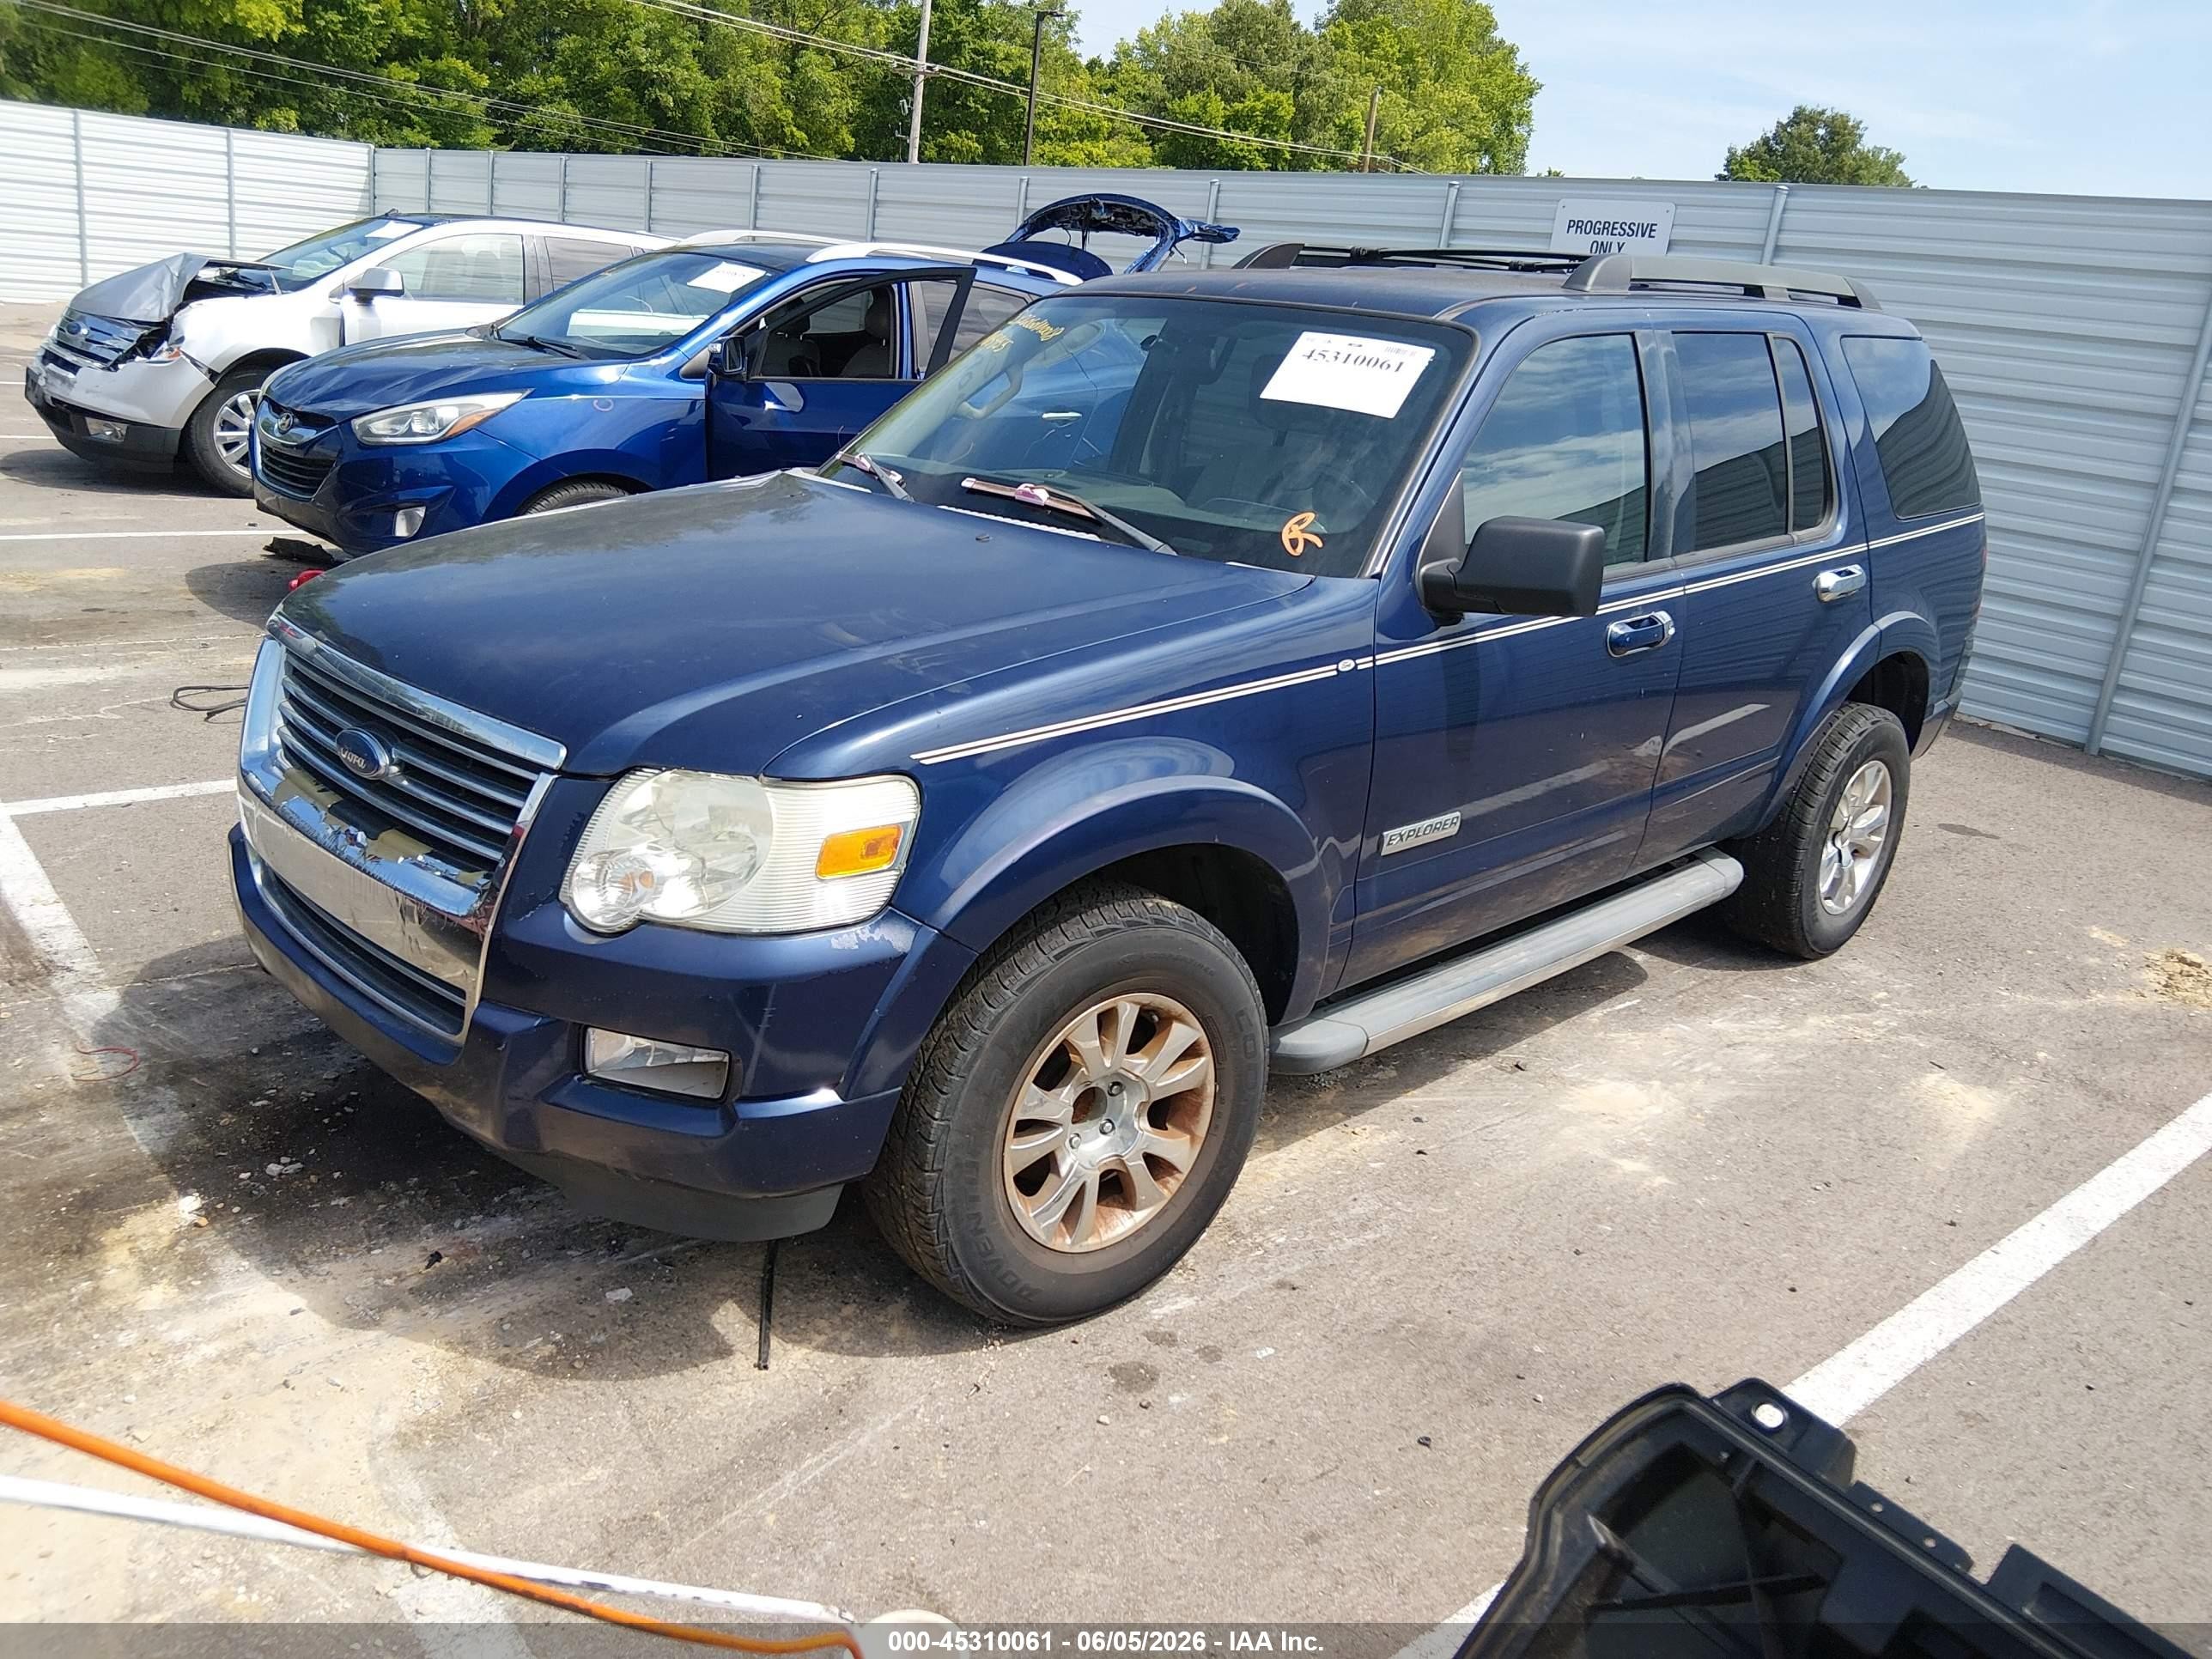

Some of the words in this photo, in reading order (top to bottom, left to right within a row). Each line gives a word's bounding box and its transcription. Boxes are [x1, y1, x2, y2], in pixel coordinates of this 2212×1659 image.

[1566, 219, 1658, 239] PROGRESSIVE
[1589, 240, 1626, 255] ONLY
[1303, 348, 1405, 373] 45310061
[1387, 816, 1460, 847] EXPLORER
